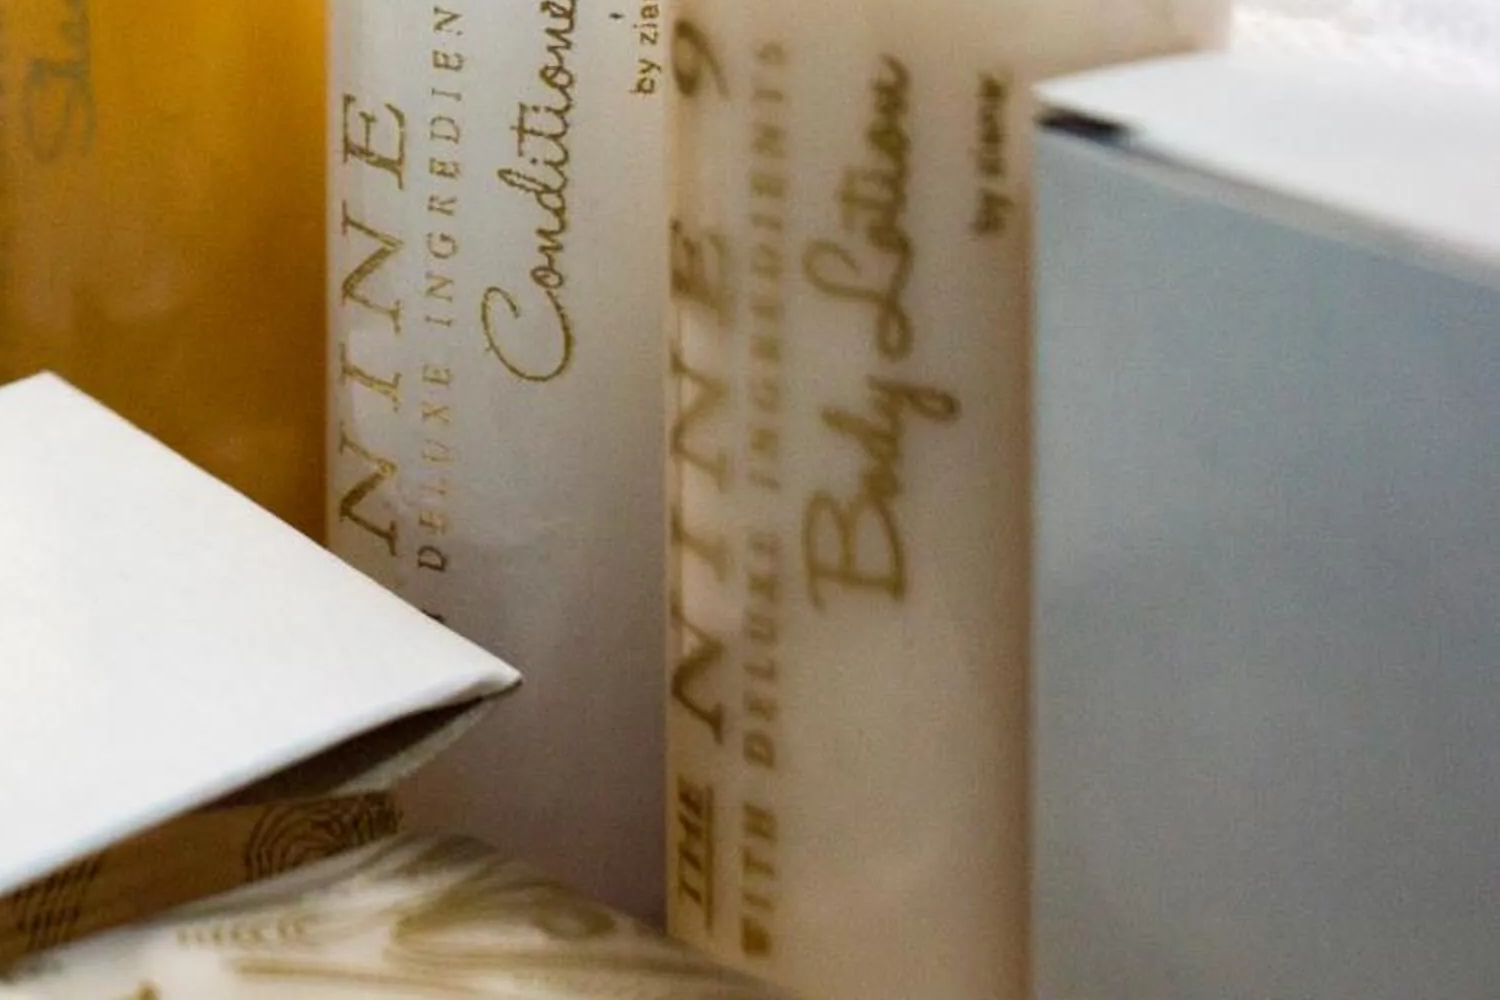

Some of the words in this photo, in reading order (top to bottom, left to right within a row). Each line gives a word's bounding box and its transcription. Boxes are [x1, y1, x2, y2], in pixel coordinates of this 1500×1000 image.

[629, 57, 662, 94] by
[672, 18, 730, 98] 9
[802, 54, 915, 360] Lotion
[339, 94, 406, 558] NINE
[416, 364, 454, 573] DELUXE
[670, 222, 737, 745] NINE
[803, 374, 962, 610] Body
